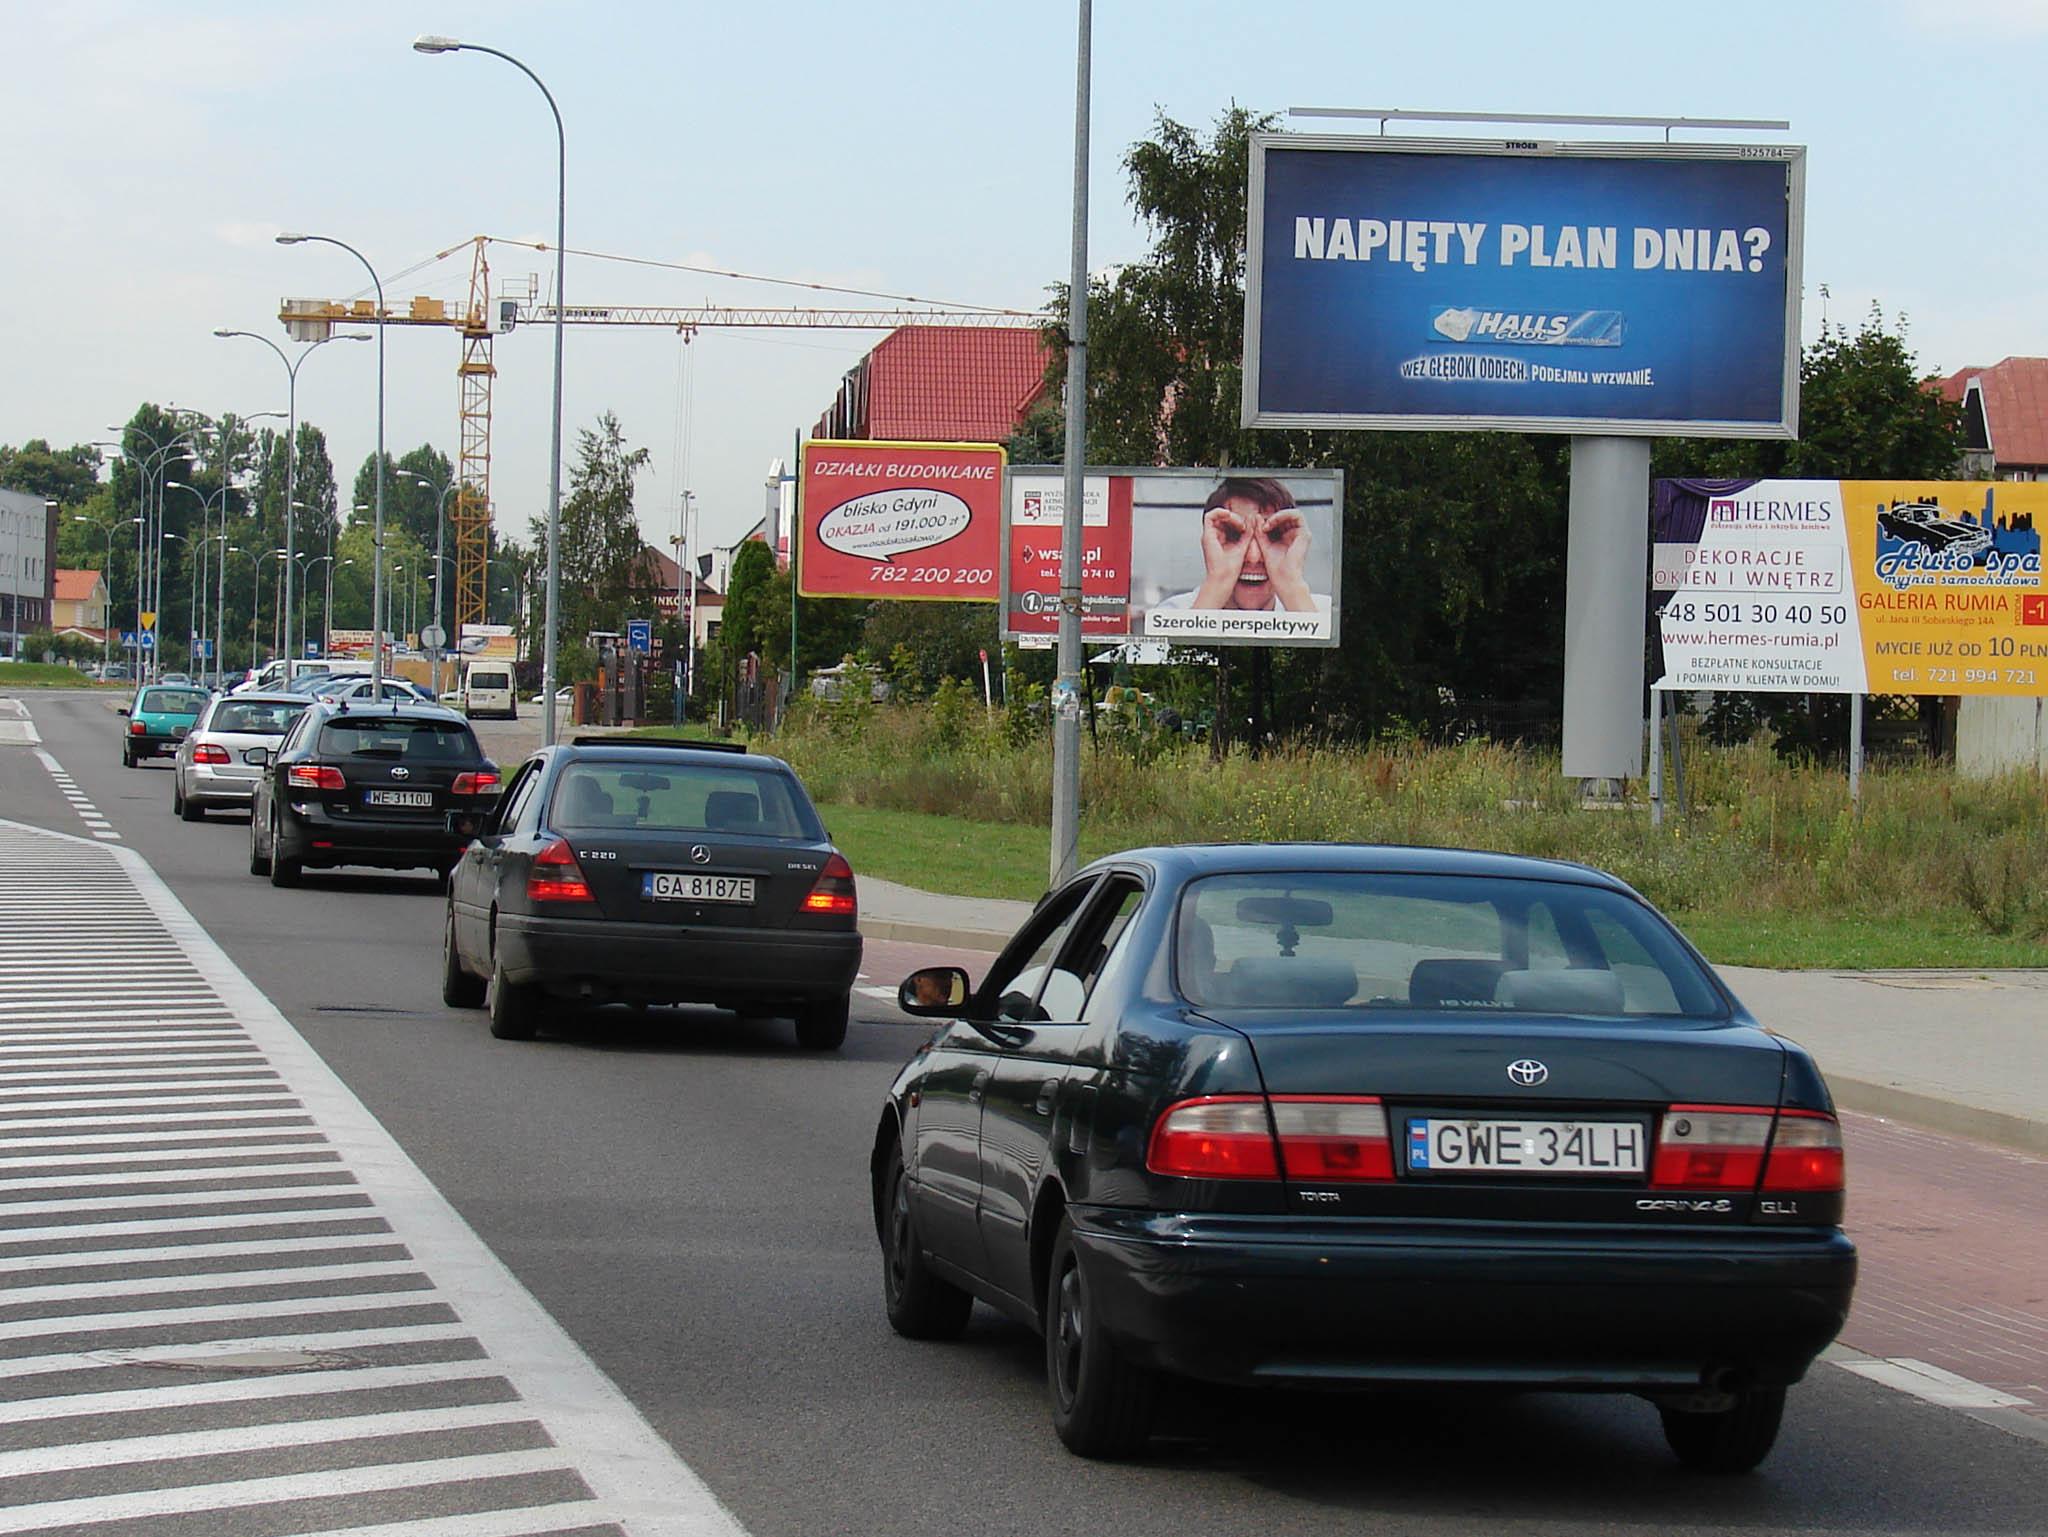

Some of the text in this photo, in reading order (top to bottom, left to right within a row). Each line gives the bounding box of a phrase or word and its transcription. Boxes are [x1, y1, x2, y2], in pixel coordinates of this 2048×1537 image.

[1294, 217, 1771, 273] NAPIĘTY PLAN DNIA?
[1476, 312, 1569, 336] HALLS
[1402, 356, 1654, 386] WEŹ GŁĘBOKI ODDECH. PODEJMIJ WYZWANIE.
[814, 461, 996, 480] DZIAŁKI BUDOWLANE
[843, 494, 939, 518] blisko Gdyni
[1736, 500, 1831, 522] HERMES
[825, 522, 875, 539] OKAZJA
[894, 515, 947, 531] 191.000
[1684, 551, 1804, 566] DEKORACJE
[1876, 541, 2041, 578] Auto spa
[870, 566, 993, 584] 782 200 200
[1654, 570, 1834, 590] OKIEN I WNĘTRZ
[1883, 573, 2040, 590] myjnia samochodowa
[1026, 594, 1039, 611] 1.
[1081, 595, 1126, 606] iepubliczna
[1859, 593, 2009, 611] GALERIA RUMIA
[2028, 600, 2046, 620] -1
[1654, 603, 1847, 625] +48 501 30 40 50
[1152, 615, 1319, 635] Szerokie perspektywy
[1662, 630, 1839, 650] www.hermes-rumia.pl
[1875, 637, 2048, 657] MYCIE JUŻ OD 10 PLN
[1691, 657, 1823, 671] BEZPŁATNE KONSULTACJE
[1683, 673, 1730, 684] POMIARY
[1734, 674, 1741, 684] U
[1746, 674, 1788, 686] KLIENTA
[1791, 675, 1800, 685] W
[1803, 676, 1840, 687] DOMU!
[1893, 668, 2036, 684] tel. 721 994 721
[372, 792, 391, 804] WE
[580, 851, 617, 860] C 220
[656, 876, 752, 899] GA 8187E
[1437, 1125, 1637, 1168] GWE 34LH
